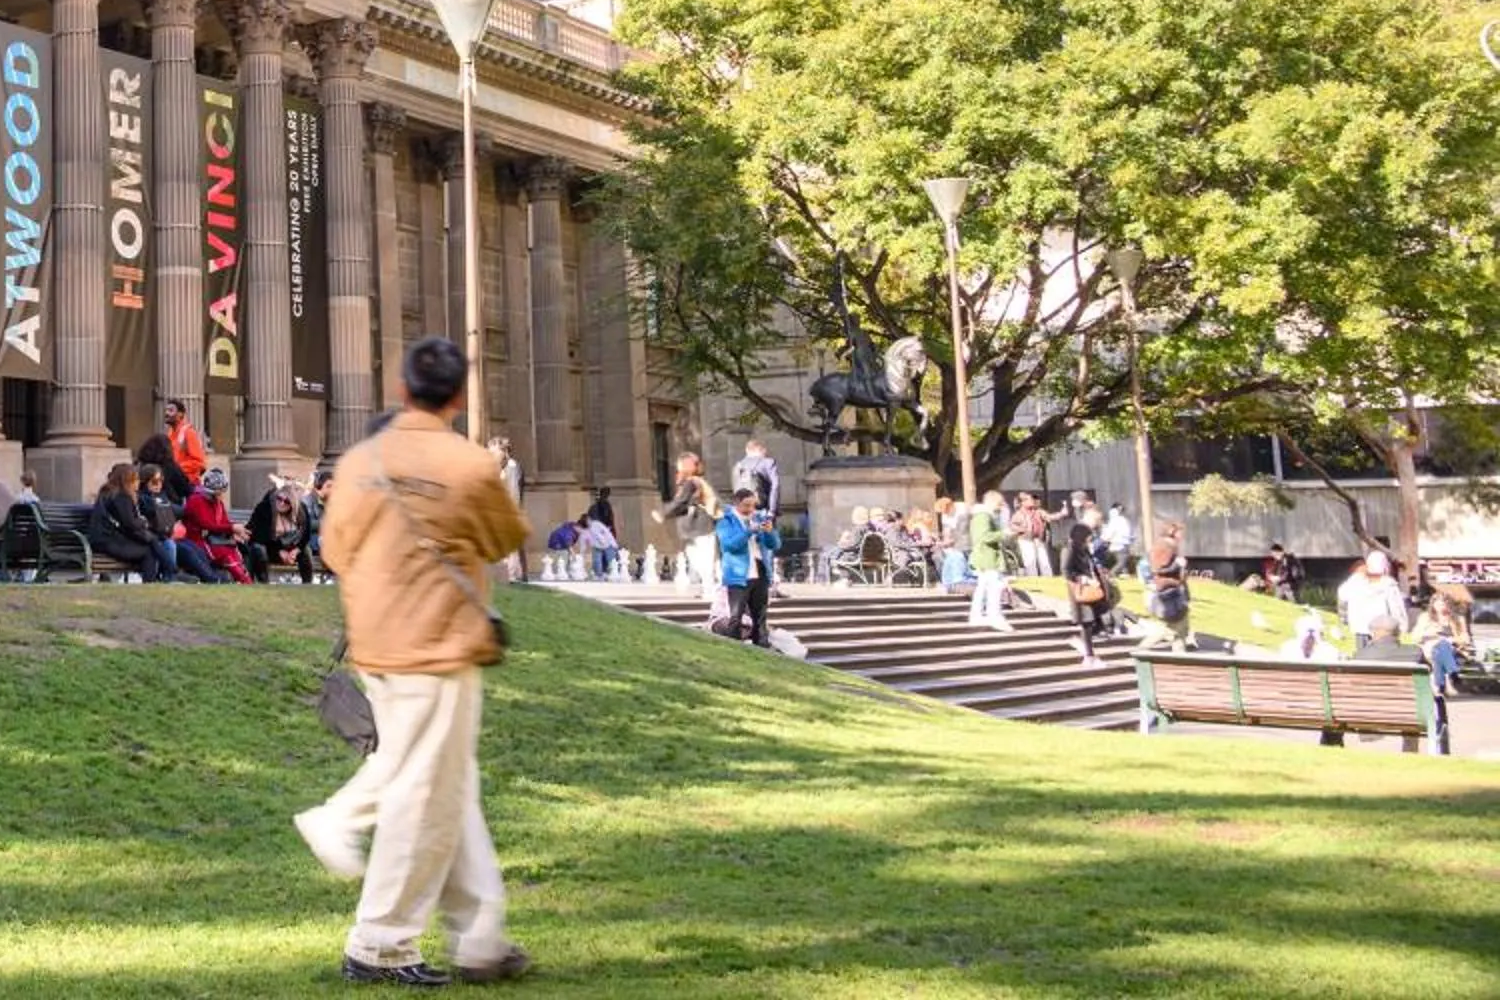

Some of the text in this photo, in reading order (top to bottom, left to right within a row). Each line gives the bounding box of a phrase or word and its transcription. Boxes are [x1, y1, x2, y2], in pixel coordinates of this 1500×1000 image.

[3, 41, 41, 364] ATWOOD
[109, 67, 144, 310] HOMER
[205, 89, 238, 380] DA VINCI
[287, 109, 303, 318] CELEBRATING 20 YEARS
[303, 185, 311, 213] FREE
[311, 153, 319, 187] OPEN
